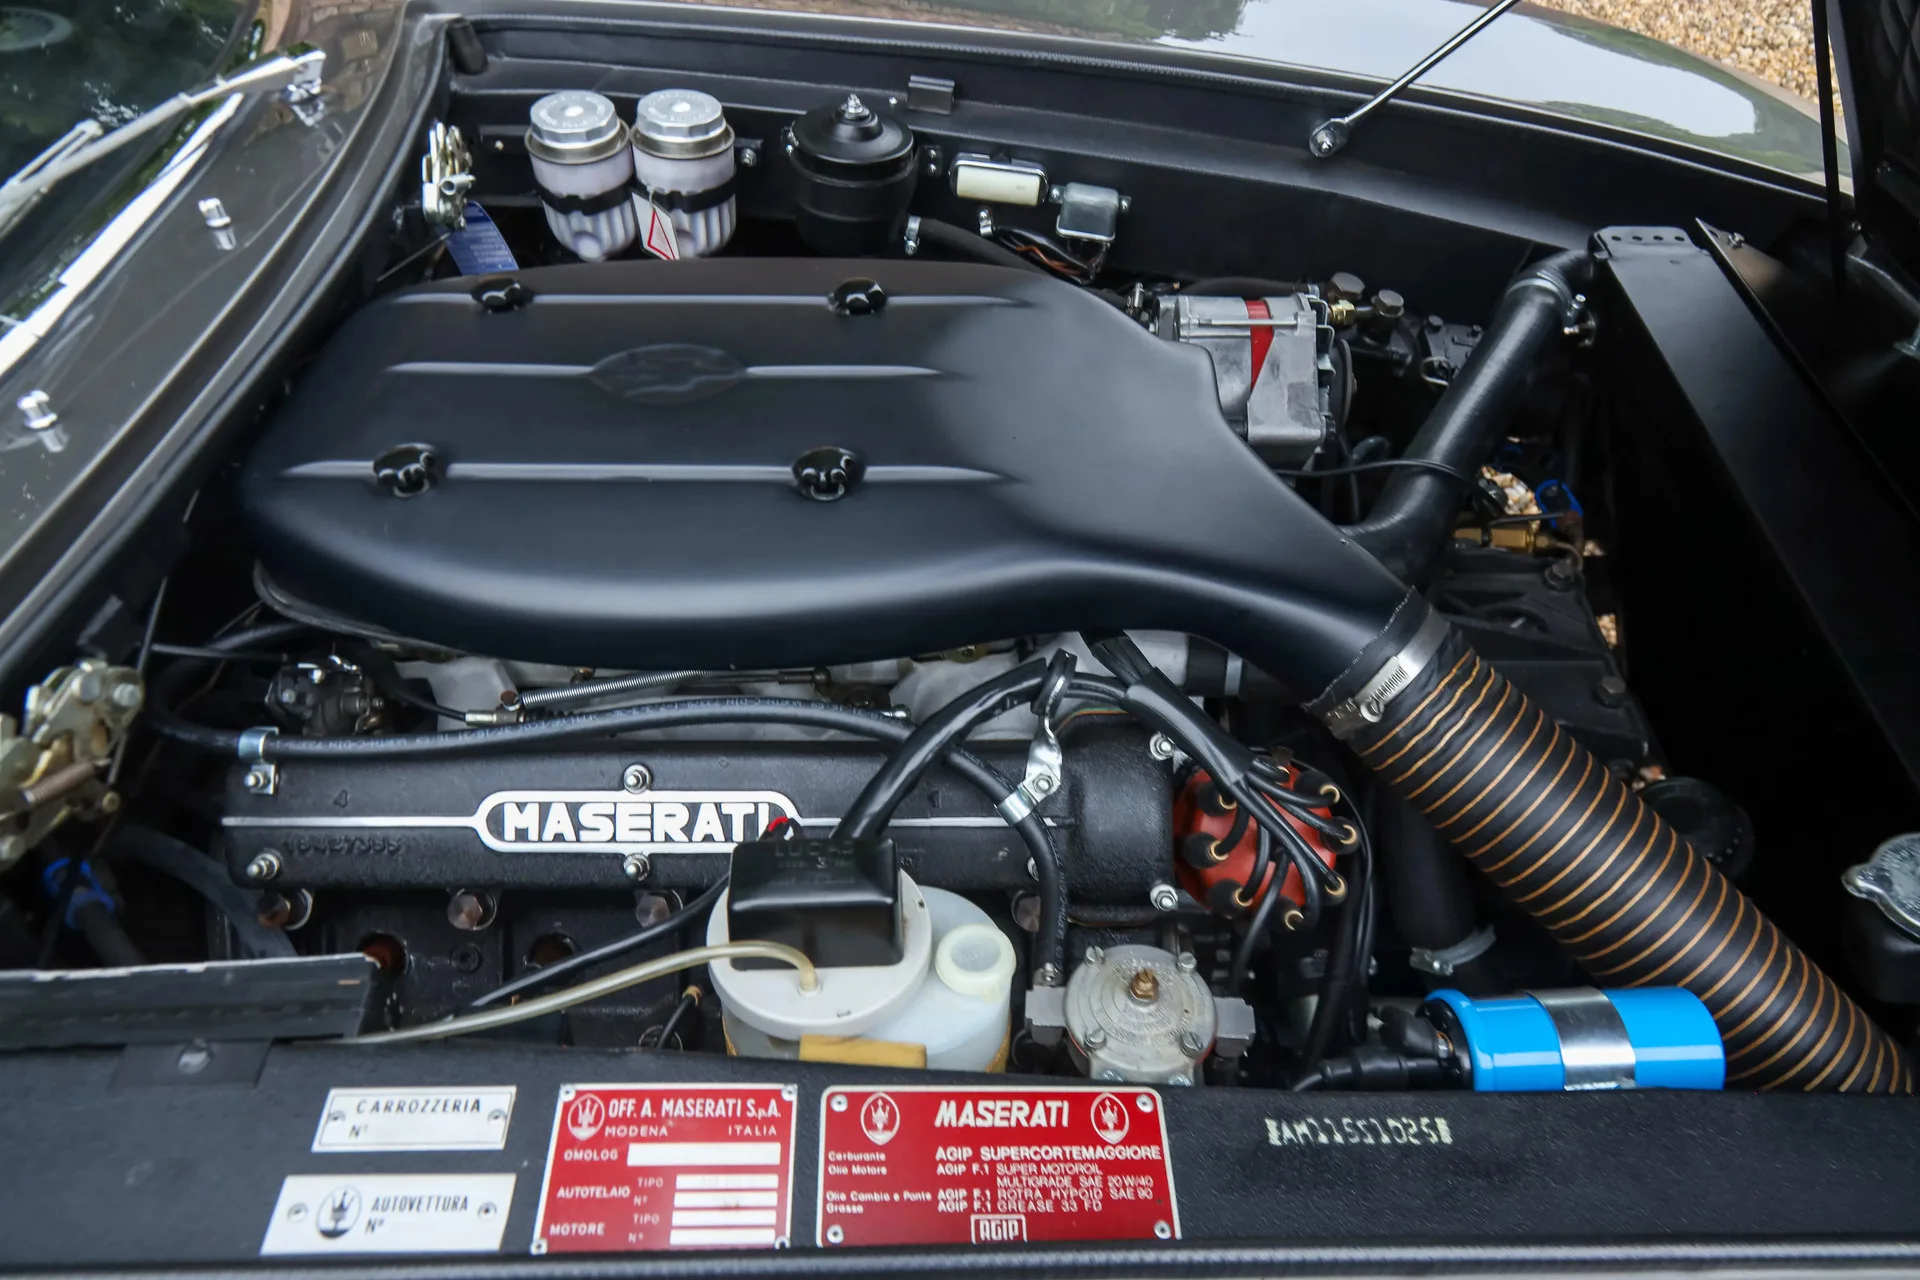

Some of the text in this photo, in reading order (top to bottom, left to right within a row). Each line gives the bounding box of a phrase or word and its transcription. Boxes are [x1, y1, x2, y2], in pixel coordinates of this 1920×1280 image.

[503, 801, 769, 842] MASERATI
[357, 1098, 481, 1114] CARROZZERIA
[608, 1098, 637, 1118] OFF.
[641, 1097, 657, 1118] A.
[661, 1098, 741, 1118] MASERATI
[934, 1100, 1069, 1128] MASERATI
[604, 1124, 777, 1138] MODENA ITALIA
[564, 1148, 618, 1161] OMOLOG
[828, 1150, 886, 1162] Carburante
[935, 1145, 1162, 1161] AGIP SUPERCORTEMAGGIORE
[828, 1164, 887, 1176] Olio Motore
[936, 1163, 967, 1176] AGIP
[996, 1163, 1038, 1176] SUPER
[1040, 1162, 1103, 1175] MOTOROIL
[637, 1177, 664, 1188] TIPO
[996, 1175, 1073, 1188] MULTIGRADE
[1079, 1175, 1104, 1188] SAE
[556, 1185, 631, 1199] AUTOTELAIO
[826, 1190, 932, 1202] Olio Cambio e Ponte
[937, 1188, 967, 1201] AGIP
[997, 1187, 1043, 1200] ROTRA
[1050, 1187, 1103, 1200] HYPOID
[1109, 1187, 1135, 1200] SAE
[371, 1195, 469, 1212] AUTOVETTURA
[826, 1202, 864, 1214] Grasso
[937, 1200, 969, 1213] AGIP
[997, 1200, 1055, 1213] GREASE
[633, 1213, 660, 1225] TIPO
[549, 1222, 606, 1236] MOTORE
[979, 1219, 1020, 1241] AGIP
